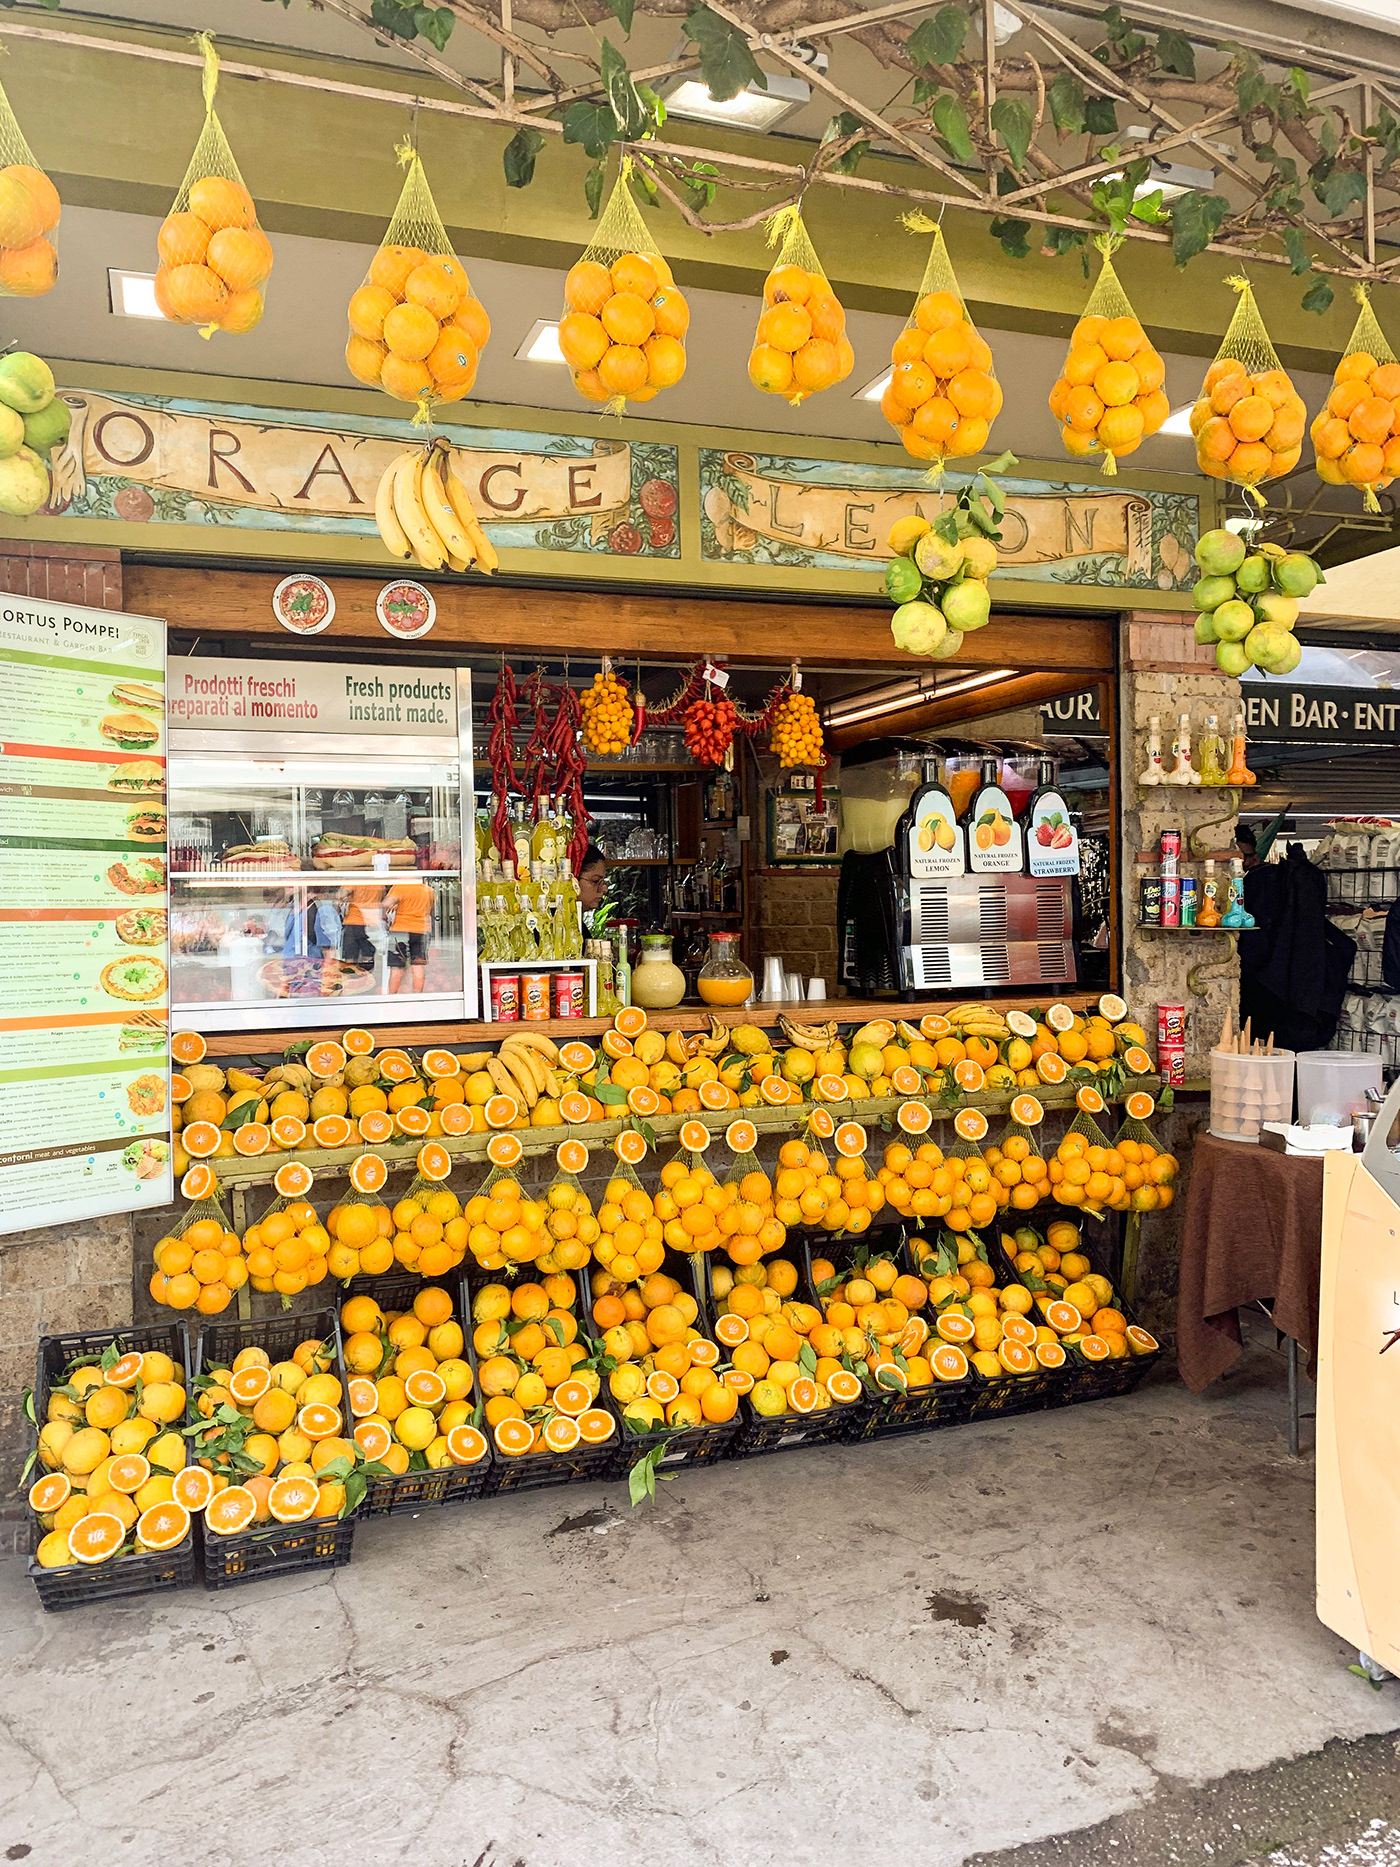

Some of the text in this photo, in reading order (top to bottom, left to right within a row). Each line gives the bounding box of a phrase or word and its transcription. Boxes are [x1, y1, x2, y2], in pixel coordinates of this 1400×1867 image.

[94, 411, 602, 511] ORAGE
[769, 484, 1098, 554] LEON
[3, 610, 119, 639] ORTUS POMPEI
[98, 646, 113, 654] BAR
[185, 674, 296, 698] Prodotti freschi
[346, 676, 451, 703] Fresh products
[234, 697, 246, 716] al
[252, 700, 318, 719] momento
[350, 700, 448, 724] instant made.
[1291, 693, 1339, 729] BAR
[1354, 703, 1400, 731] ENT
[1034, 867, 1076, 875] STRAWBERRY
[65, 1145, 96, 1155] vegetables
